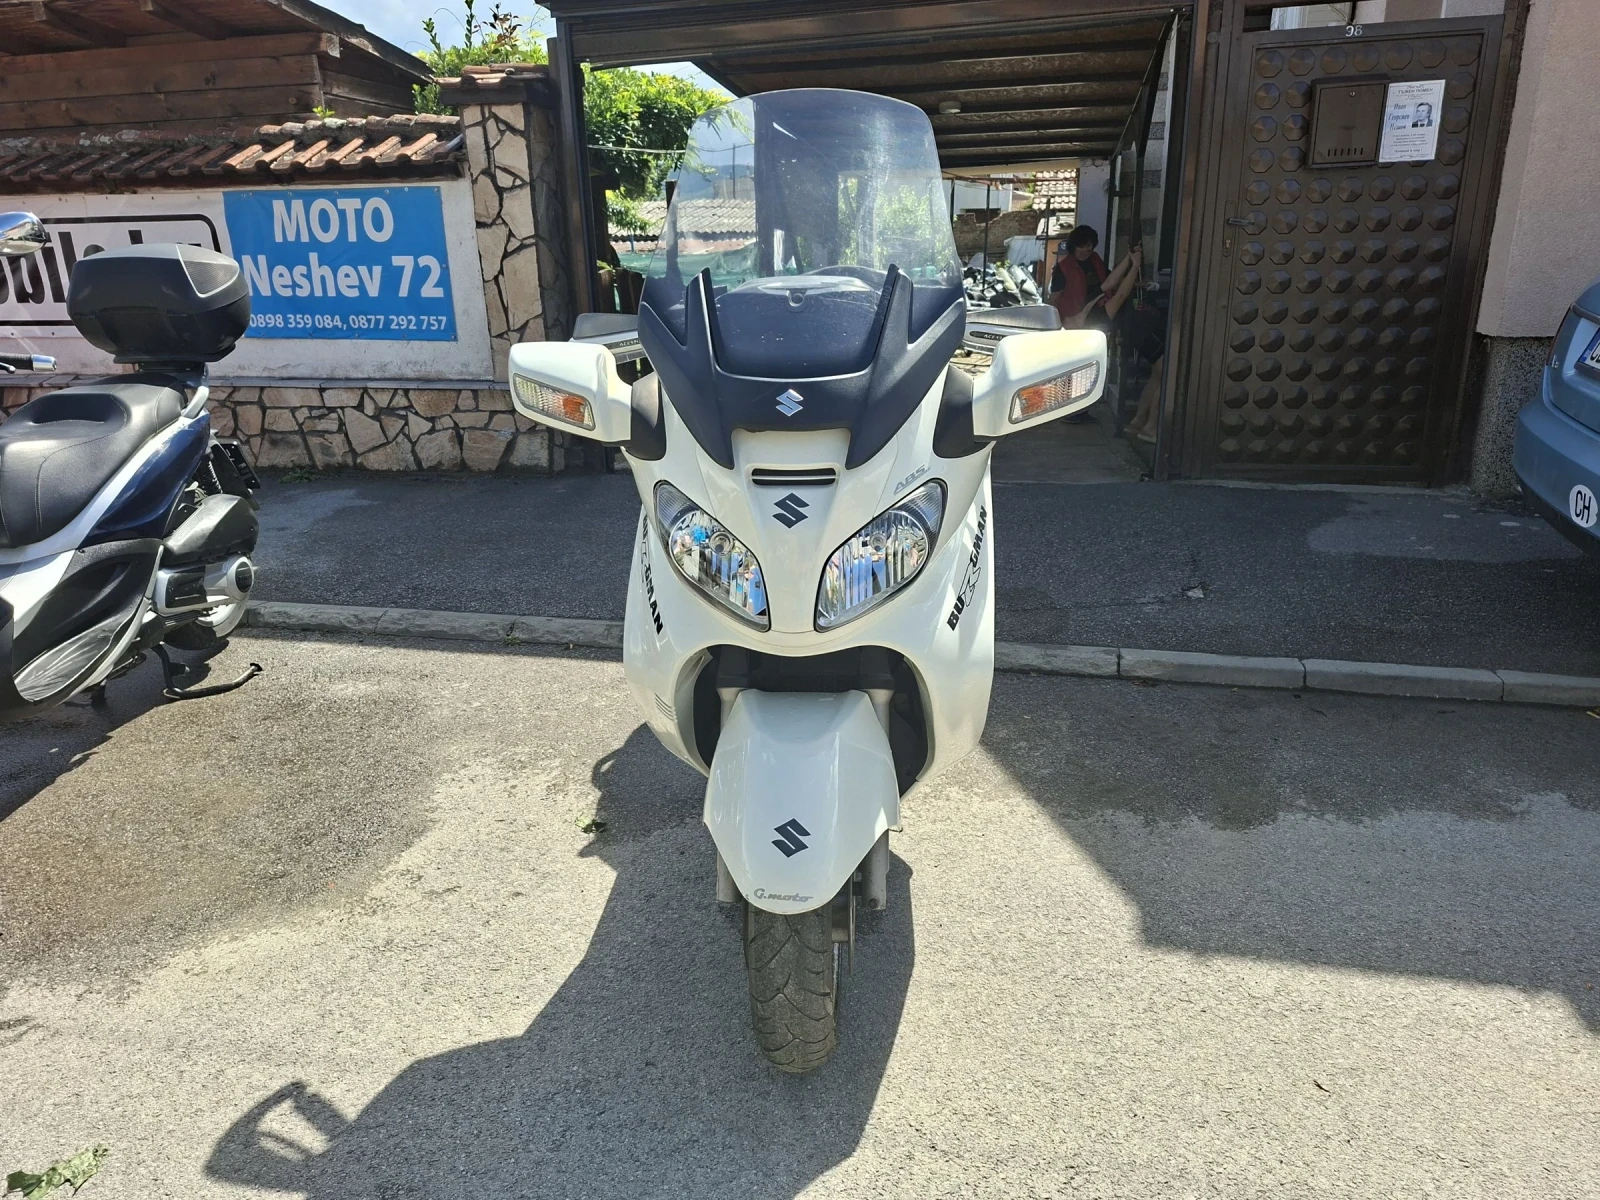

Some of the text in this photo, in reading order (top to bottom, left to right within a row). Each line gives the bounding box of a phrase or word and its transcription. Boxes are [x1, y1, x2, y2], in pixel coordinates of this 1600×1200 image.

[1345, 25, 1363, 37] 98
[272, 197, 394, 243] MOTO
[241, 252, 382, 298] Neshev
[391, 255, 444, 298] 72
[250, 313, 447, 331] 0898 359 084, 0877 292 757
[1574, 490, 1592, 524] CH
[946, 505, 988, 631] BURGMAN
